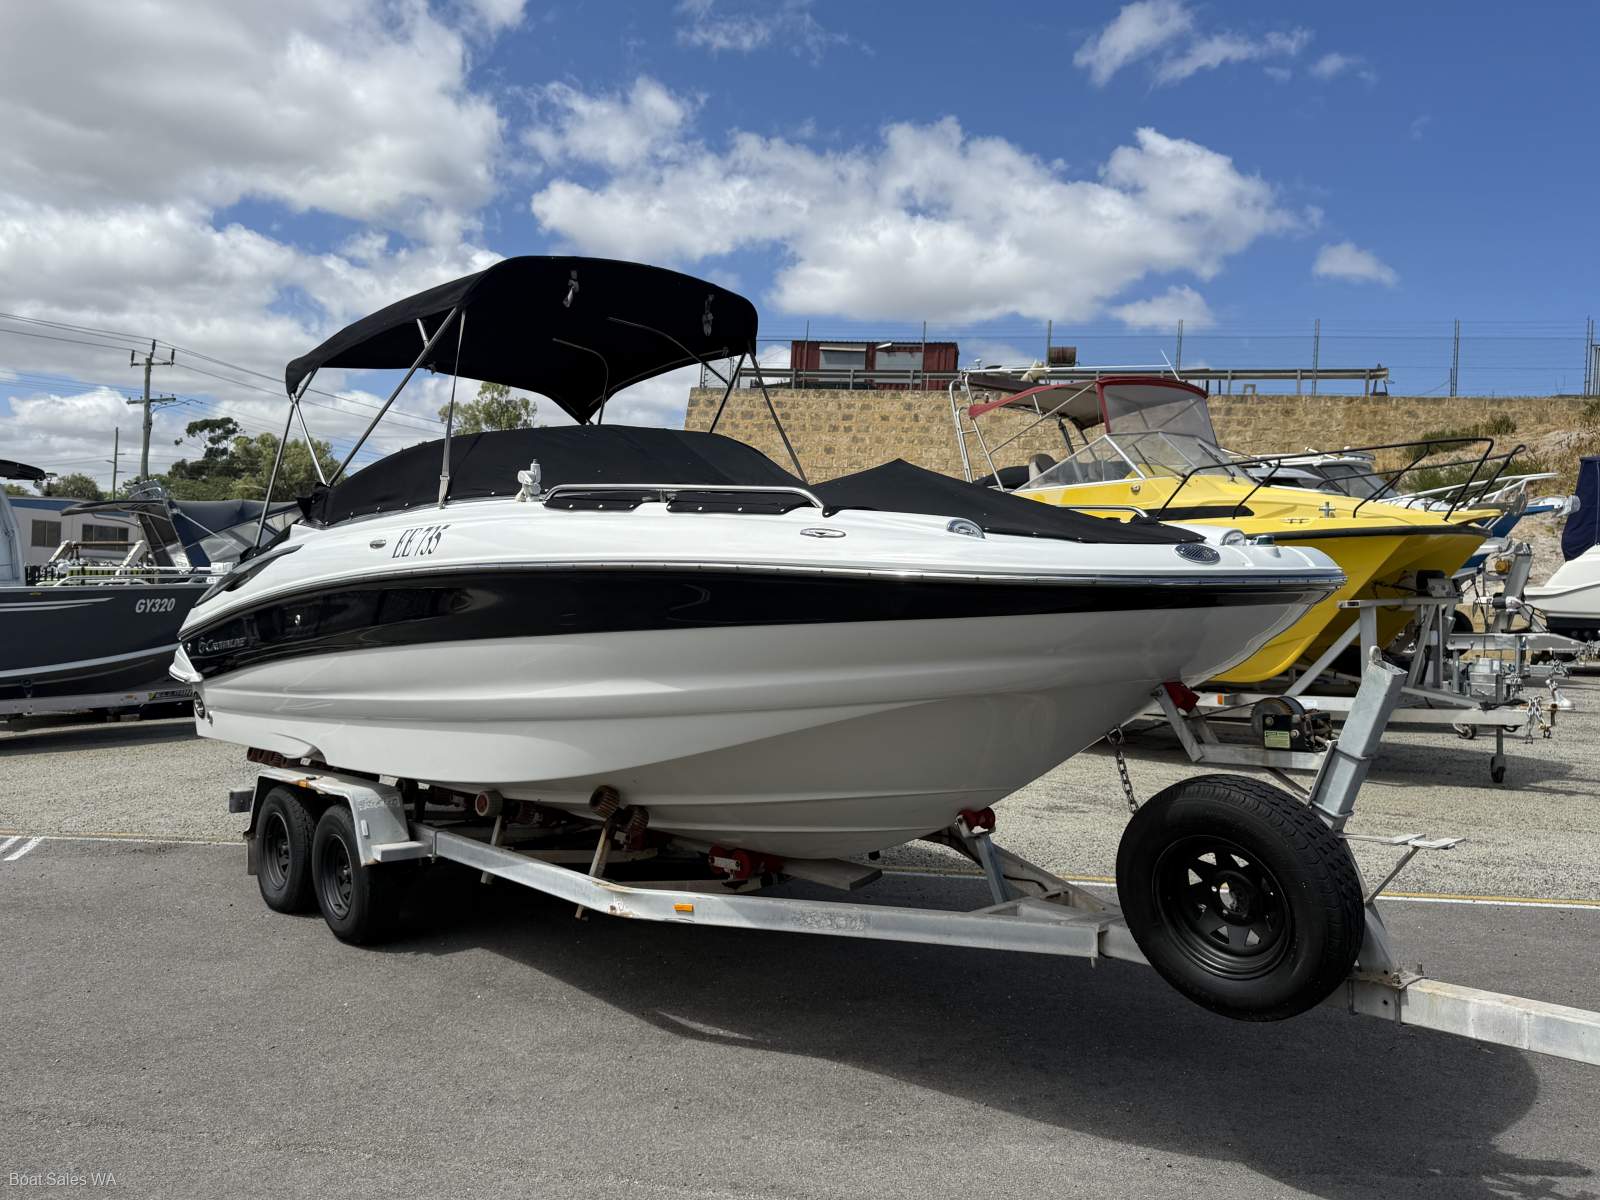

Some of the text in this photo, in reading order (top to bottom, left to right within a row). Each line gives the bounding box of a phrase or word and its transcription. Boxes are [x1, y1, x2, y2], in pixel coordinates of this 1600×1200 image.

[391, 524, 451, 559] EE 735
[135, 597, 176, 614] GY320
